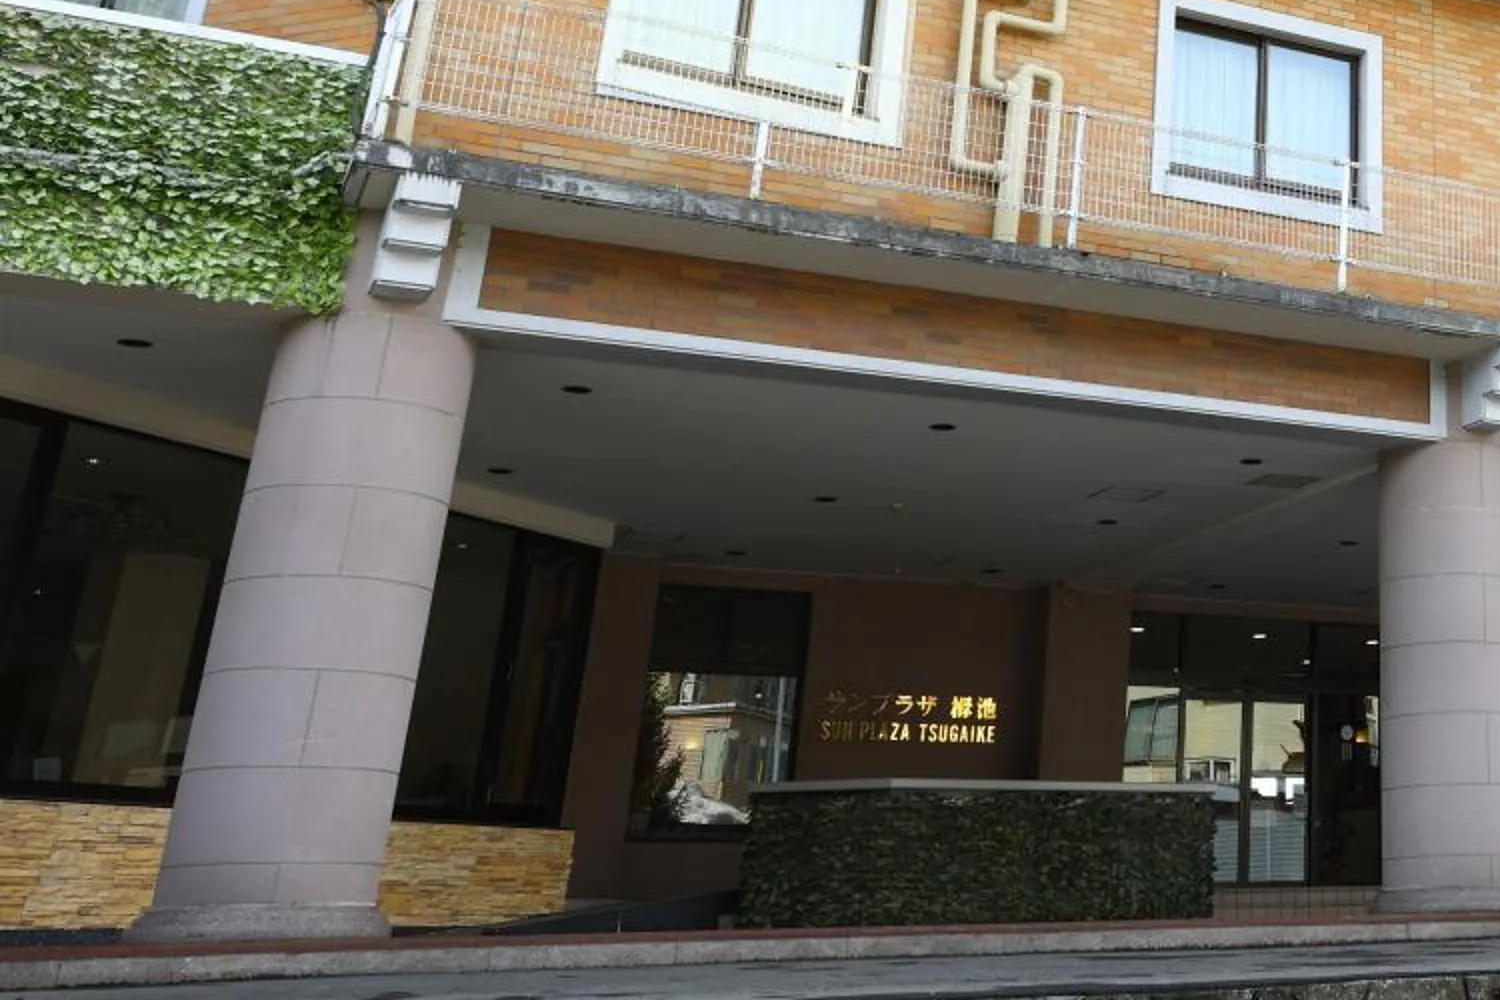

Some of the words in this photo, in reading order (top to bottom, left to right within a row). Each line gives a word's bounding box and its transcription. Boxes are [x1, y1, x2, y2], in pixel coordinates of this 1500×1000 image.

[824, 689, 938, 717] サンプラザ
[819, 719, 853, 743] SUN
[858, 720, 910, 742] PLAZA
[919, 723, 998, 744] TSUGAIKE
